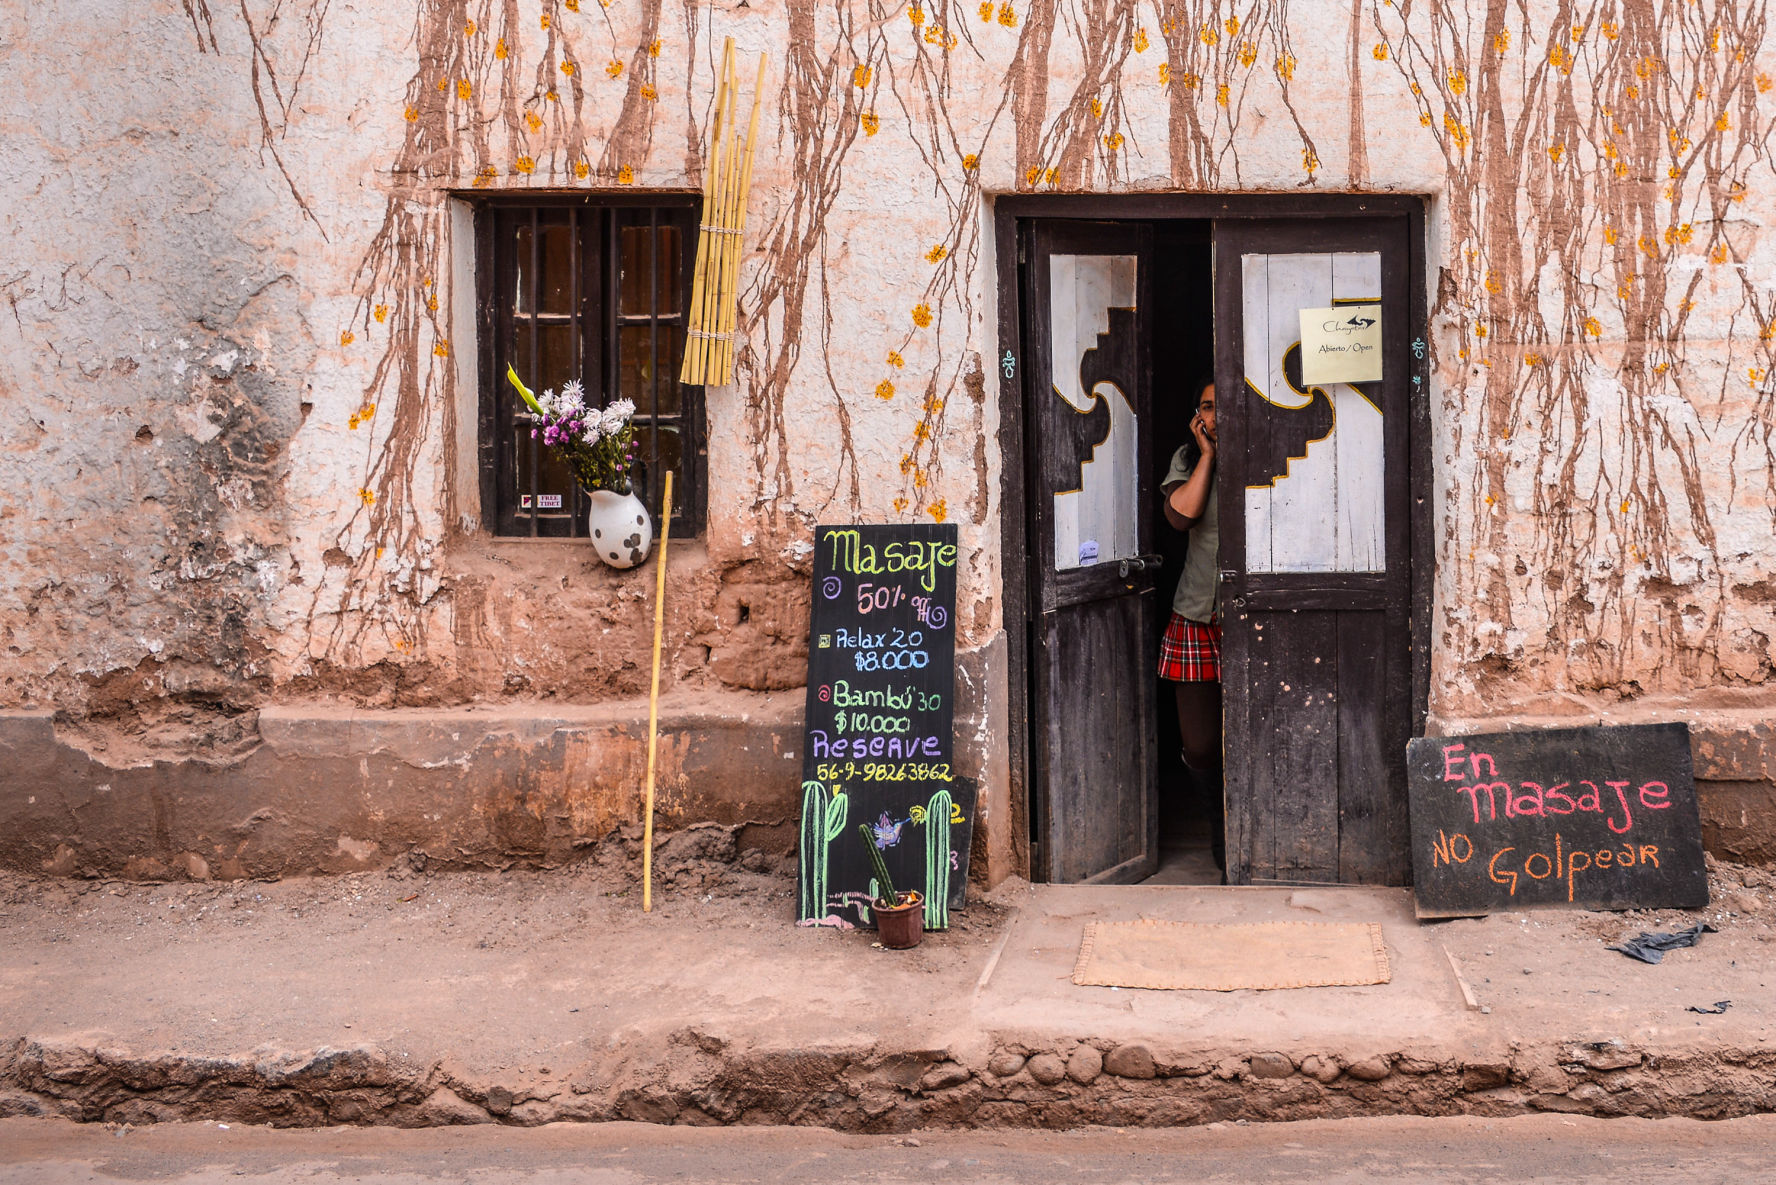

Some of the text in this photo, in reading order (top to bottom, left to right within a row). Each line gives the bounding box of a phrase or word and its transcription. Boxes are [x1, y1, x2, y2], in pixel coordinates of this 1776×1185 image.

[1318, 344, 1346, 354] Abierto
[1352, 342, 1373, 354] Open
[857, 583, 906, 614] 50%
[836, 627, 887, 648] Relax
[855, 649, 929, 671] $8.000
[1442, 743, 1498, 782] En
